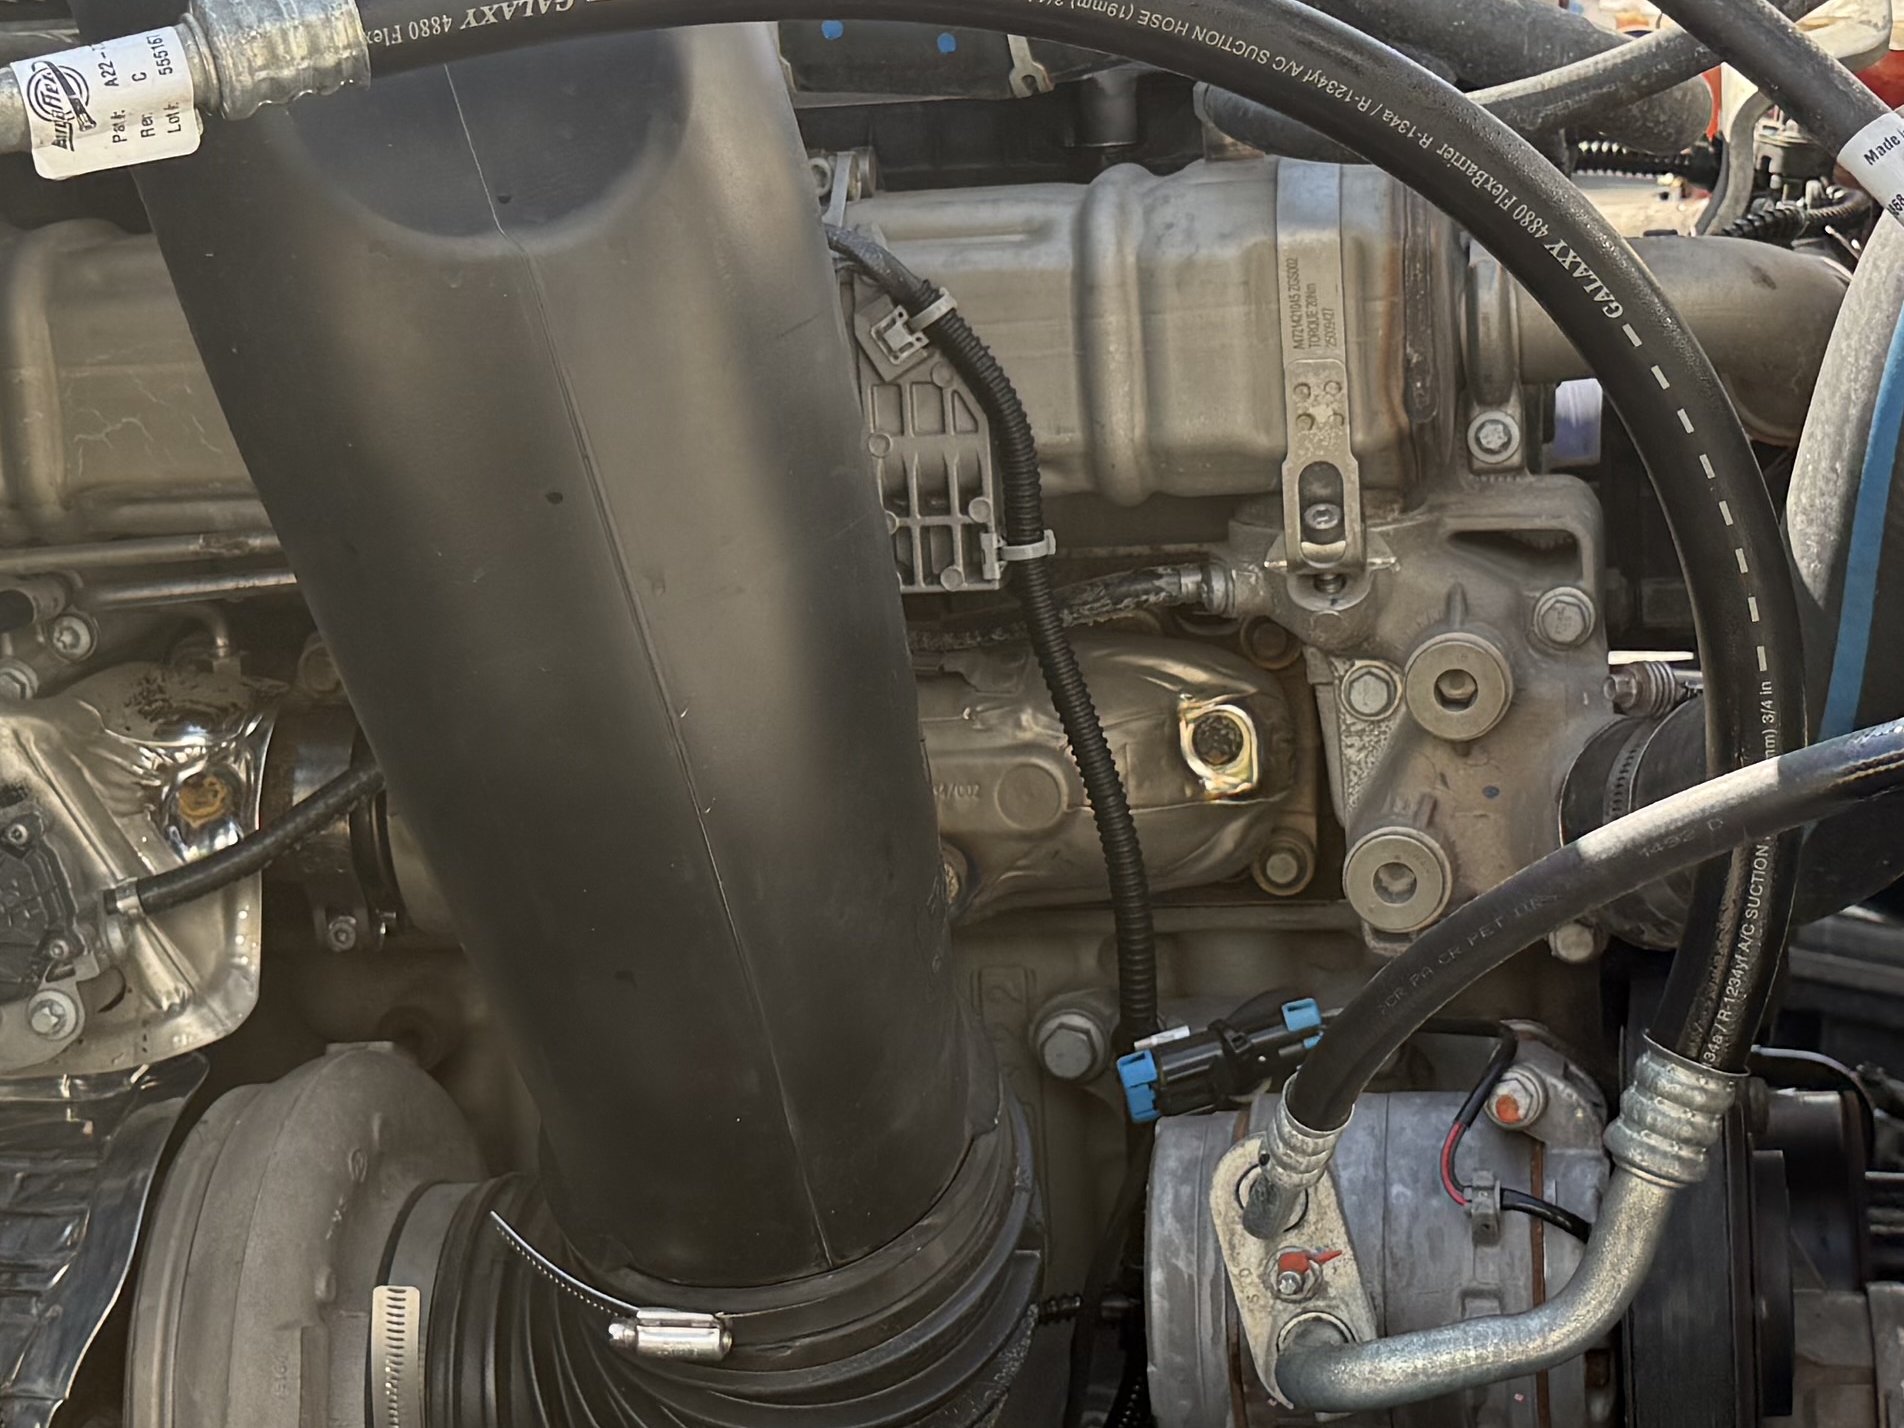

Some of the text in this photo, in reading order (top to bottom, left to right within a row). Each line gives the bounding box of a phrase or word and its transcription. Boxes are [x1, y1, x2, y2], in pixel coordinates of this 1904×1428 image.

[407, 13, 454, 39] 4880
[1137, 7, 1189, 37] HOSE
[1193, 25, 1271, 65] SUCTION
[131, 71, 147, 83] C
[1272, 54, 1302, 80] A/C
[1382, 107, 1434, 150] R-134a
[1863, 135, 1900, 165] Made
[1436, 142, 1517, 211] FlexBarrier
[1512, 202, 1550, 241] 4880
[1543, 238, 1624, 319] GALAXY
[1305, 310, 1321, 350] TORQUE
[1759, 700, 1776, 723] 3/4
[1719, 955, 1750, 1022] R-1234yf
[1736, 923, 1756, 952] A/C
[1746, 844, 1770, 919] SUCTION
